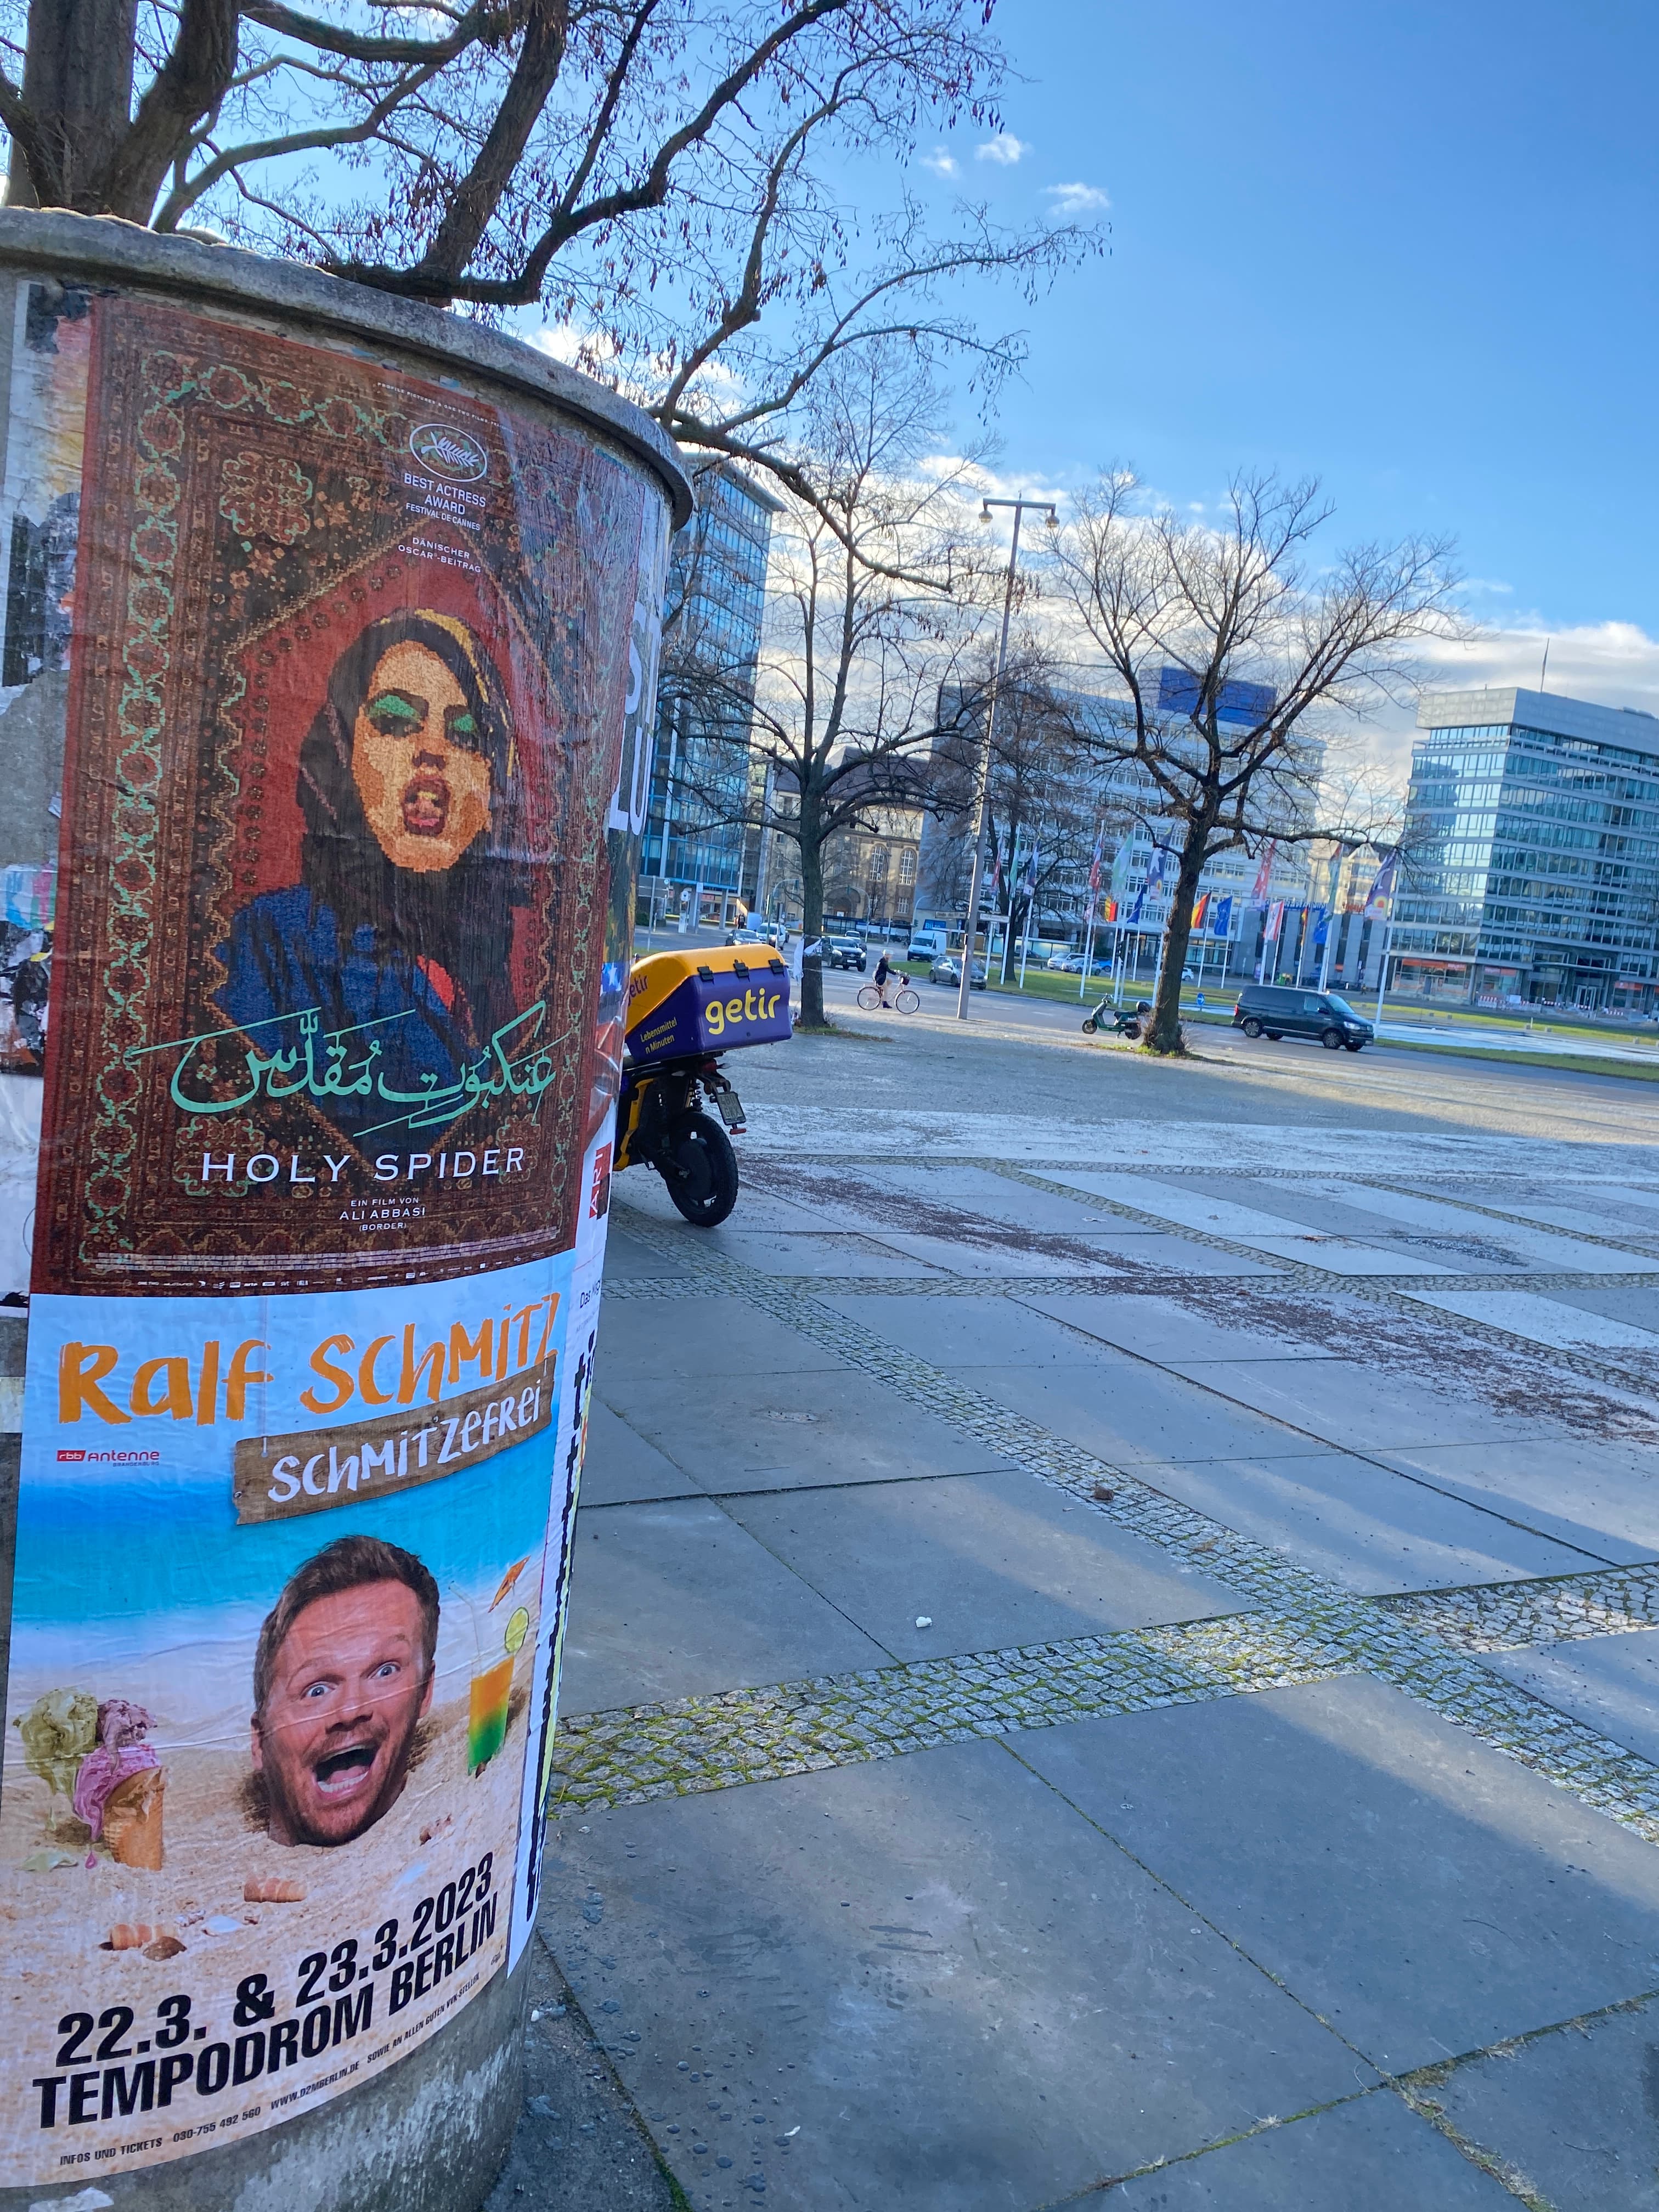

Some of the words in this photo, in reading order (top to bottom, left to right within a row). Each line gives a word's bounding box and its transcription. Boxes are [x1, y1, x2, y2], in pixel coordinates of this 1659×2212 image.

[404, 472, 434, 490] BEST
[436, 483, 486, 507] ACTRESS
[406, 503, 439, 518] FESTIVAL
[441, 512, 451, 522] DE
[452, 516, 481, 531] CANNES
[425, 494, 465, 515] AWARD
[412, 537, 470, 559] DÄNISCHER
[705, 988, 781, 1035] getir
[640, 1016, 678, 1043] Lebensmittel
[650, 1034, 675, 1053] Minuten
[201, 1152, 351, 1183] HOLY
[374, 1147, 525, 1181] SPIDER
[339, 1210, 365, 1220] ALI
[370, 1206, 426, 1219] ABBASI
[359, 1222, 407, 1232] (BORDER)
[58, 1339, 274, 1426] Ralf
[88, 1450, 160, 1462] Antenne
[55, 1994, 207, 2068] 22.3.
[233, 1973, 275, 2027] &
[296, 1852, 493, 2008] 23.3.2023
[33, 1983, 373, 2129] TEMPODROM
[388, 1892, 498, 2016] BERLIN
[60, 2152, 91, 2166] INFOS
[94, 2148, 116, 2160] UND
[121, 2137, 162, 2154] TICKETS
[173, 2122, 216, 2143] 030-755
[219, 2114, 239, 2129] 492
[367, 2044, 390, 2064] SOWIE
[392, 2035, 403, 2048] AN
[404, 2019, 424, 2040] ALLEN
[425, 2005, 445, 2025] GUTEN
